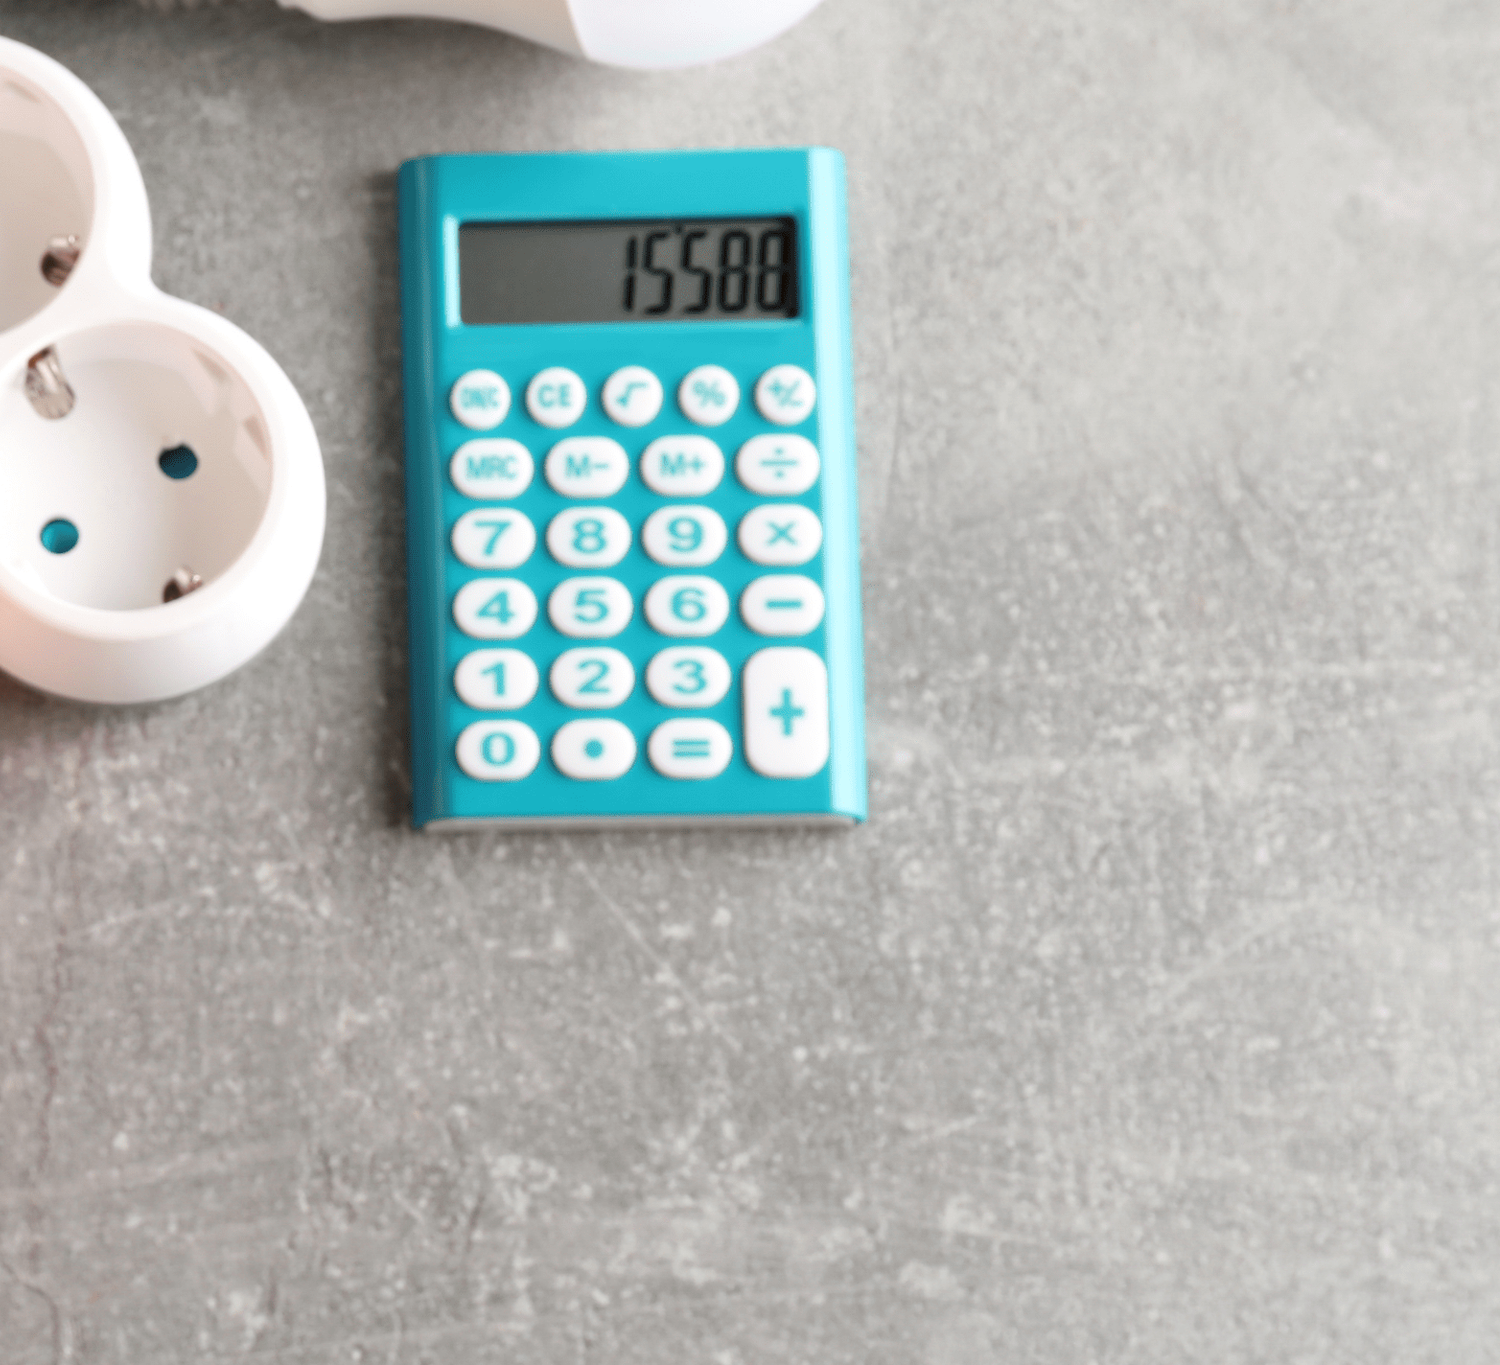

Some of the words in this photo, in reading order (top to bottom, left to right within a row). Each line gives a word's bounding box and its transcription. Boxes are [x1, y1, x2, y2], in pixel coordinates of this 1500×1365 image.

[537, 383, 573, 409] CE
[465, 455, 518, 480] MRC
[660, 452, 706, 477] M+
[474, 520, 513, 556] 7
[571, 518, 607, 555] 8
[666, 517, 705, 553] 9
[475, 590, 516, 625] 4
[574, 589, 610, 623] 5
[671, 587, 708, 623] 6
[480, 661, 507, 697] 1
[575, 659, 612, 694] 2
[672, 659, 708, 694] 3
[480, 731, 516, 767] 0
